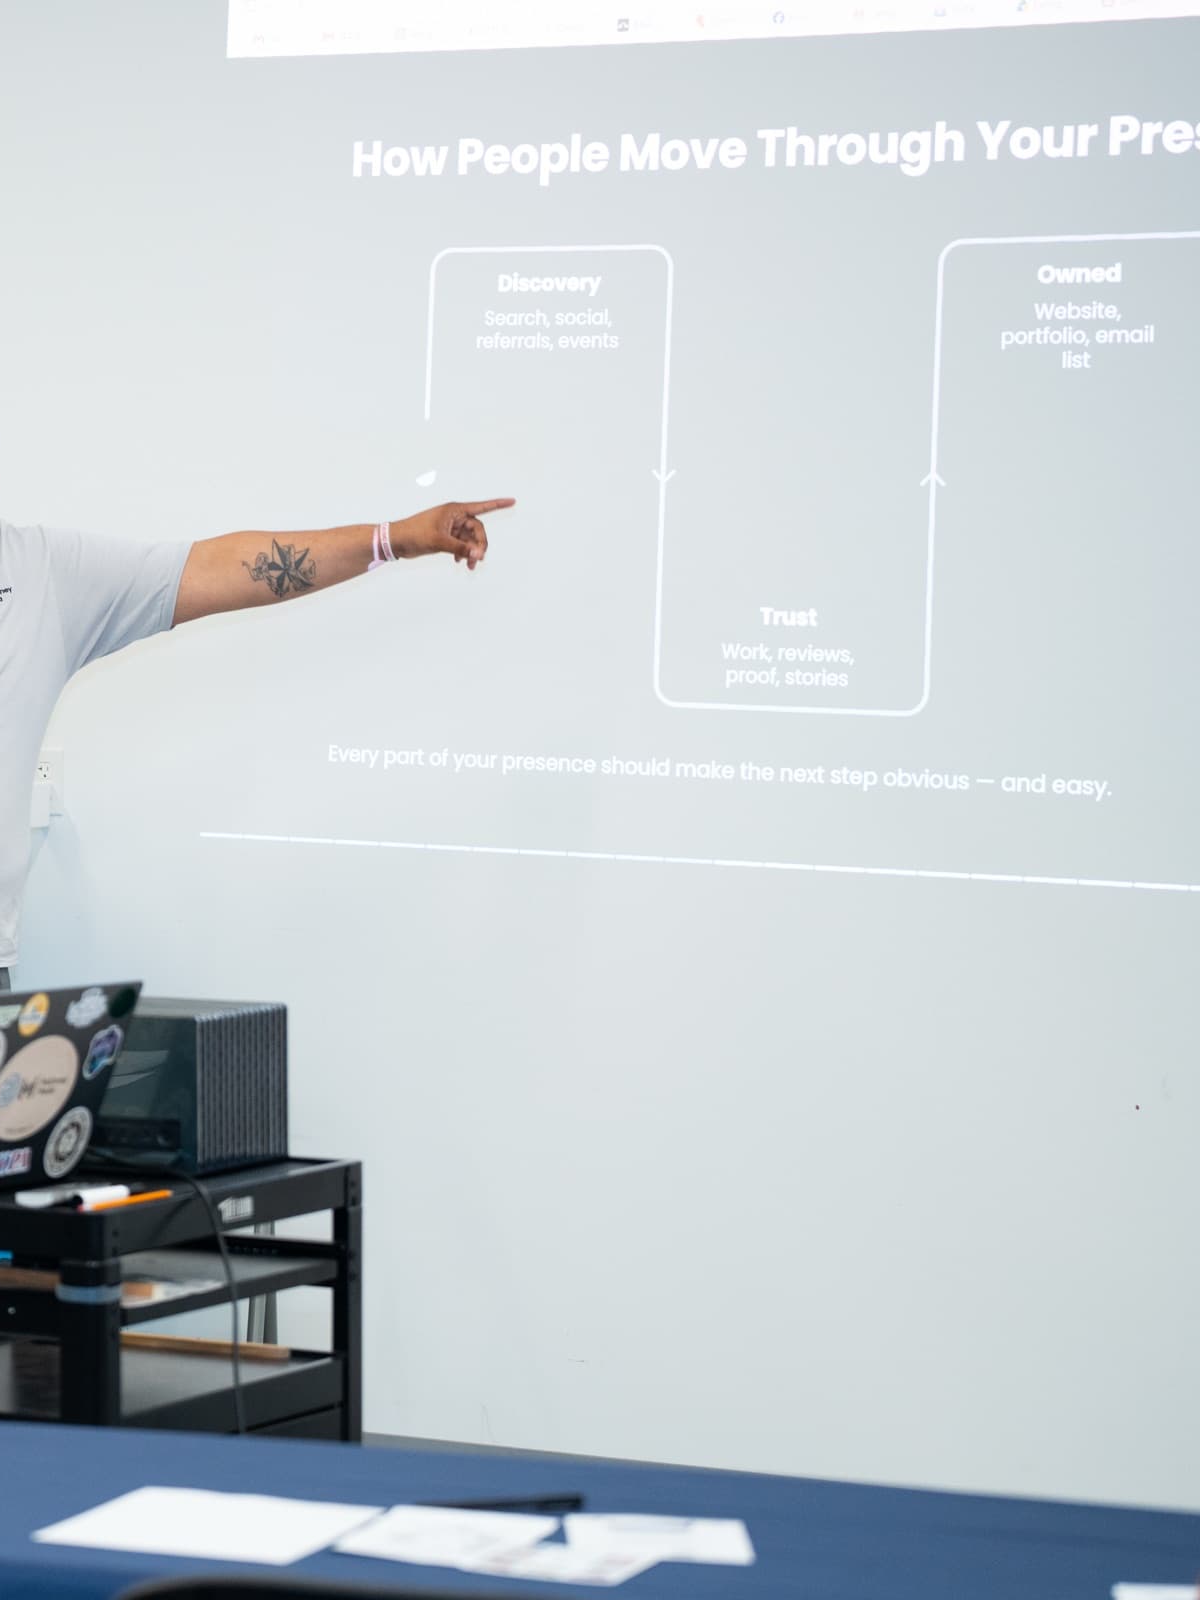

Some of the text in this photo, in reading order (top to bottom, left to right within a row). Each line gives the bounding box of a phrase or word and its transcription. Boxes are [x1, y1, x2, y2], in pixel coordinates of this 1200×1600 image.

[352, 114, 1200, 187] How People Move Through Your Pre
[497, 271, 603, 297] Discovery
[1036, 262, 1123, 285] Owned
[484, 307, 613, 329] Search, social,
[1033, 300, 1123, 323] Website,
[475, 332, 620, 353] referrals, events
[1000, 324, 1156, 350] portfolio, email
[1061, 349, 1092, 369] list
[759, 606, 819, 628] Trust
[721, 642, 855, 666] Work, reviews,
[725, 665, 849, 689] proof, stories
[327, 743, 381, 769] Every
[383, 748, 425, 770] part
[428, 747, 449, 768] of
[452, 752, 499, 774] your
[501, 754, 597, 776] presence
[600, 755, 671, 777] should
[675, 759, 736, 781] make
[739, 760, 776, 782] the
[779, 764, 826, 785] next
[829, 764, 879, 791] step
[882, 767, 971, 791] obvious
[1000, 772, 1047, 795] and
[1051, 777, 1113, 803] easy.
